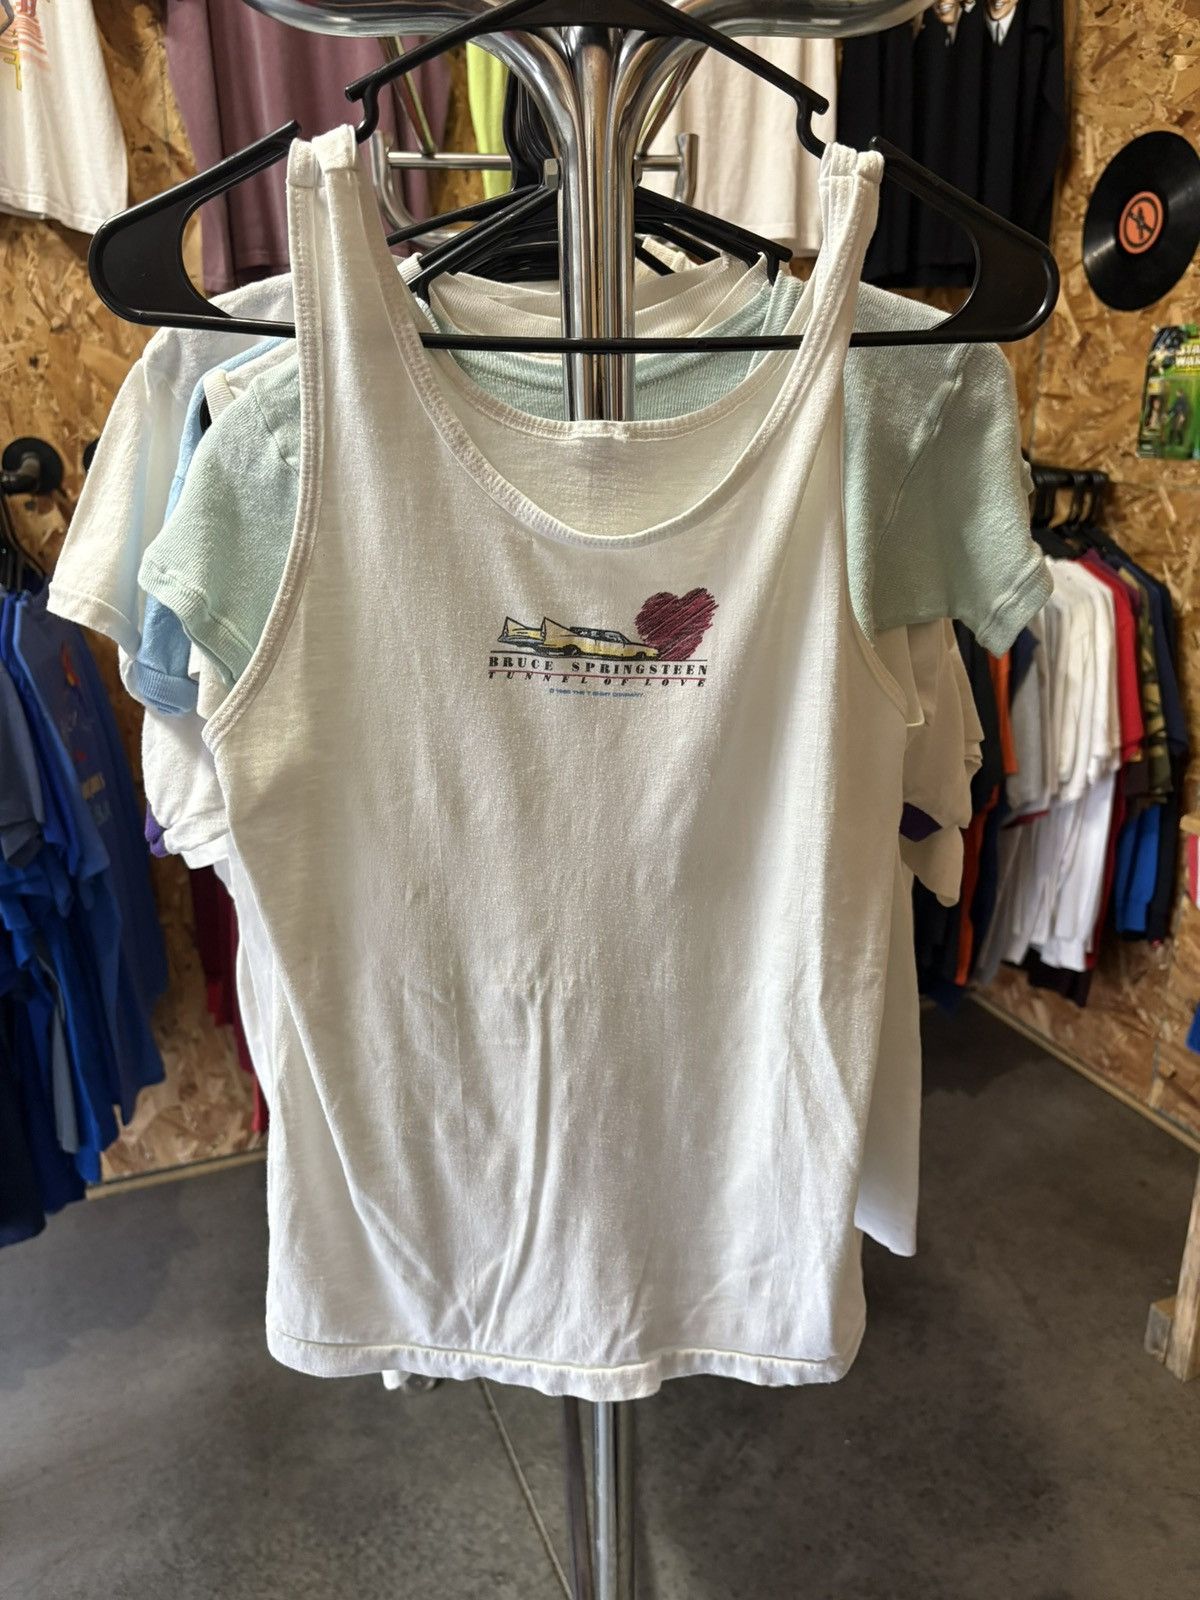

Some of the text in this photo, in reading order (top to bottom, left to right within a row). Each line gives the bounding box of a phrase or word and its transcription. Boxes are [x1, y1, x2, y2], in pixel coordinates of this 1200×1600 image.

[489, 656, 707, 675] BRUCE SPRINGSTEEN
[488, 672, 706, 687] TUNNEL OF LOVE
